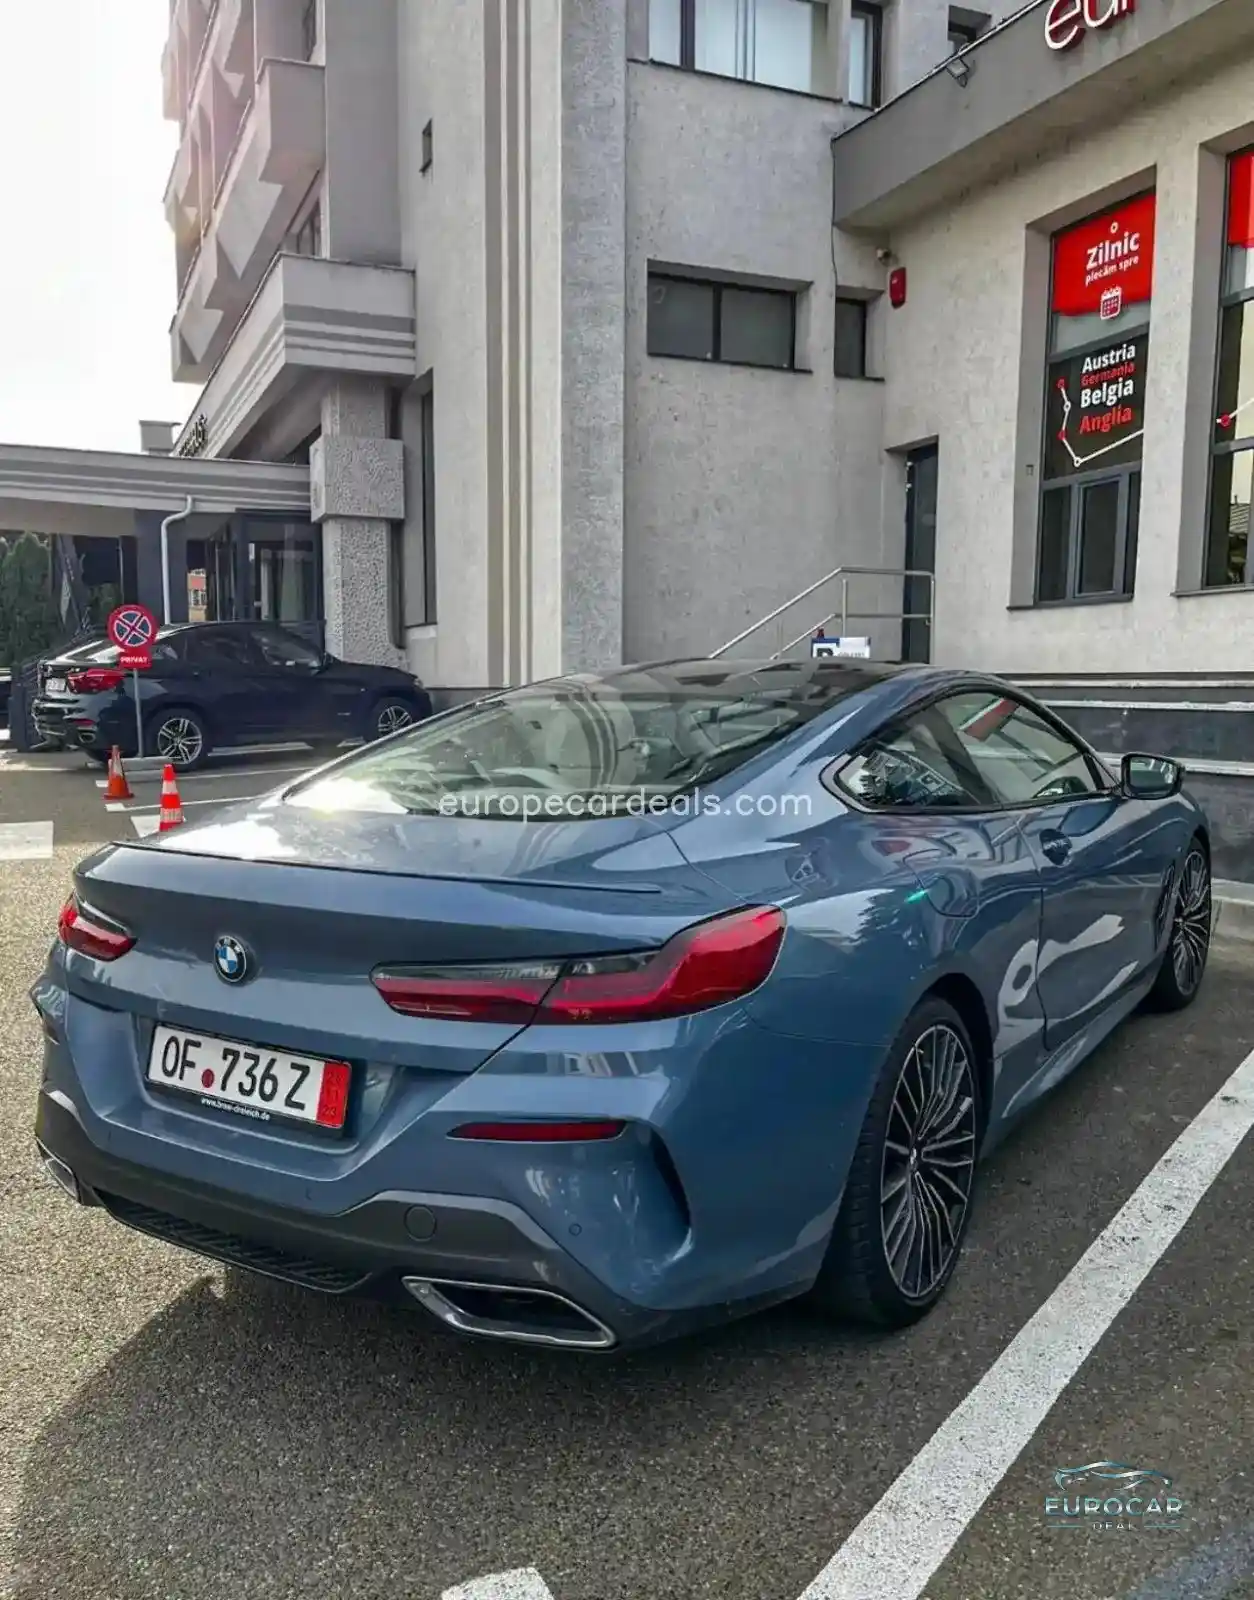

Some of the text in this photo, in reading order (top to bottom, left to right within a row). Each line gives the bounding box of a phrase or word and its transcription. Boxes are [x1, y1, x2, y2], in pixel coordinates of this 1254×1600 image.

[1044, 0, 1128, 50] eu
[1086, 231, 1140, 270] Zilnic
[1119, 255, 1139, 271] spre
[1082, 344, 1136, 373] Austria
[1081, 361, 1135, 386] Germania
[1081, 377, 1134, 408] Belgia
[1080, 405, 1132, 434] Anglia
[120, 655, 149, 665] PRIVAT
[162, 1035, 202, 1081] OF
